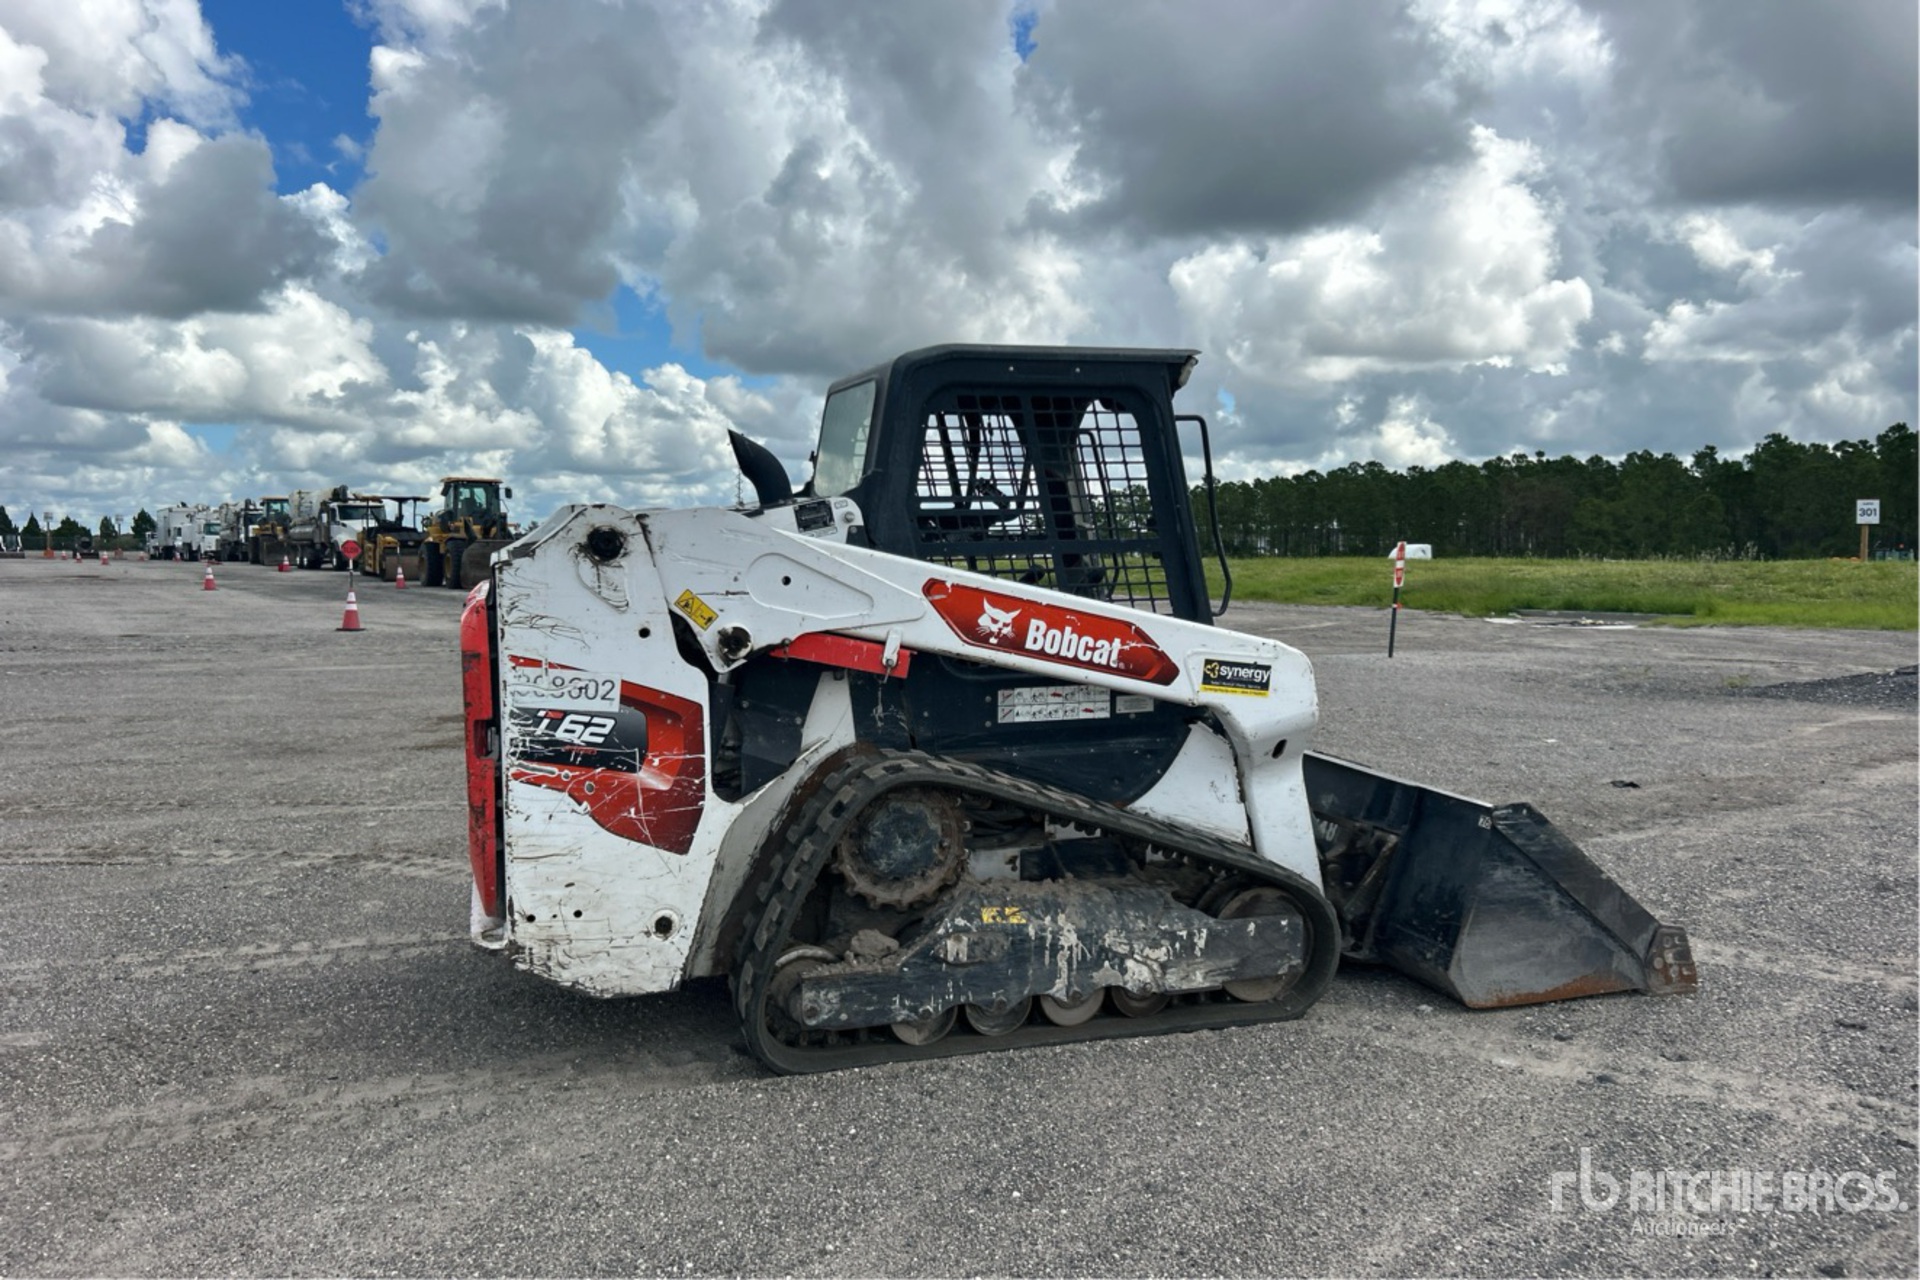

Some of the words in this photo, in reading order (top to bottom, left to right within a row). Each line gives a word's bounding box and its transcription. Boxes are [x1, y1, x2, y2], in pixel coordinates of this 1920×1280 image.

[1859, 507, 1877, 517] 301
[1025, 618, 1122, 668] Bobcat
[1220, 665, 1271, 683] synergy
[537, 710, 616, 744] T62
